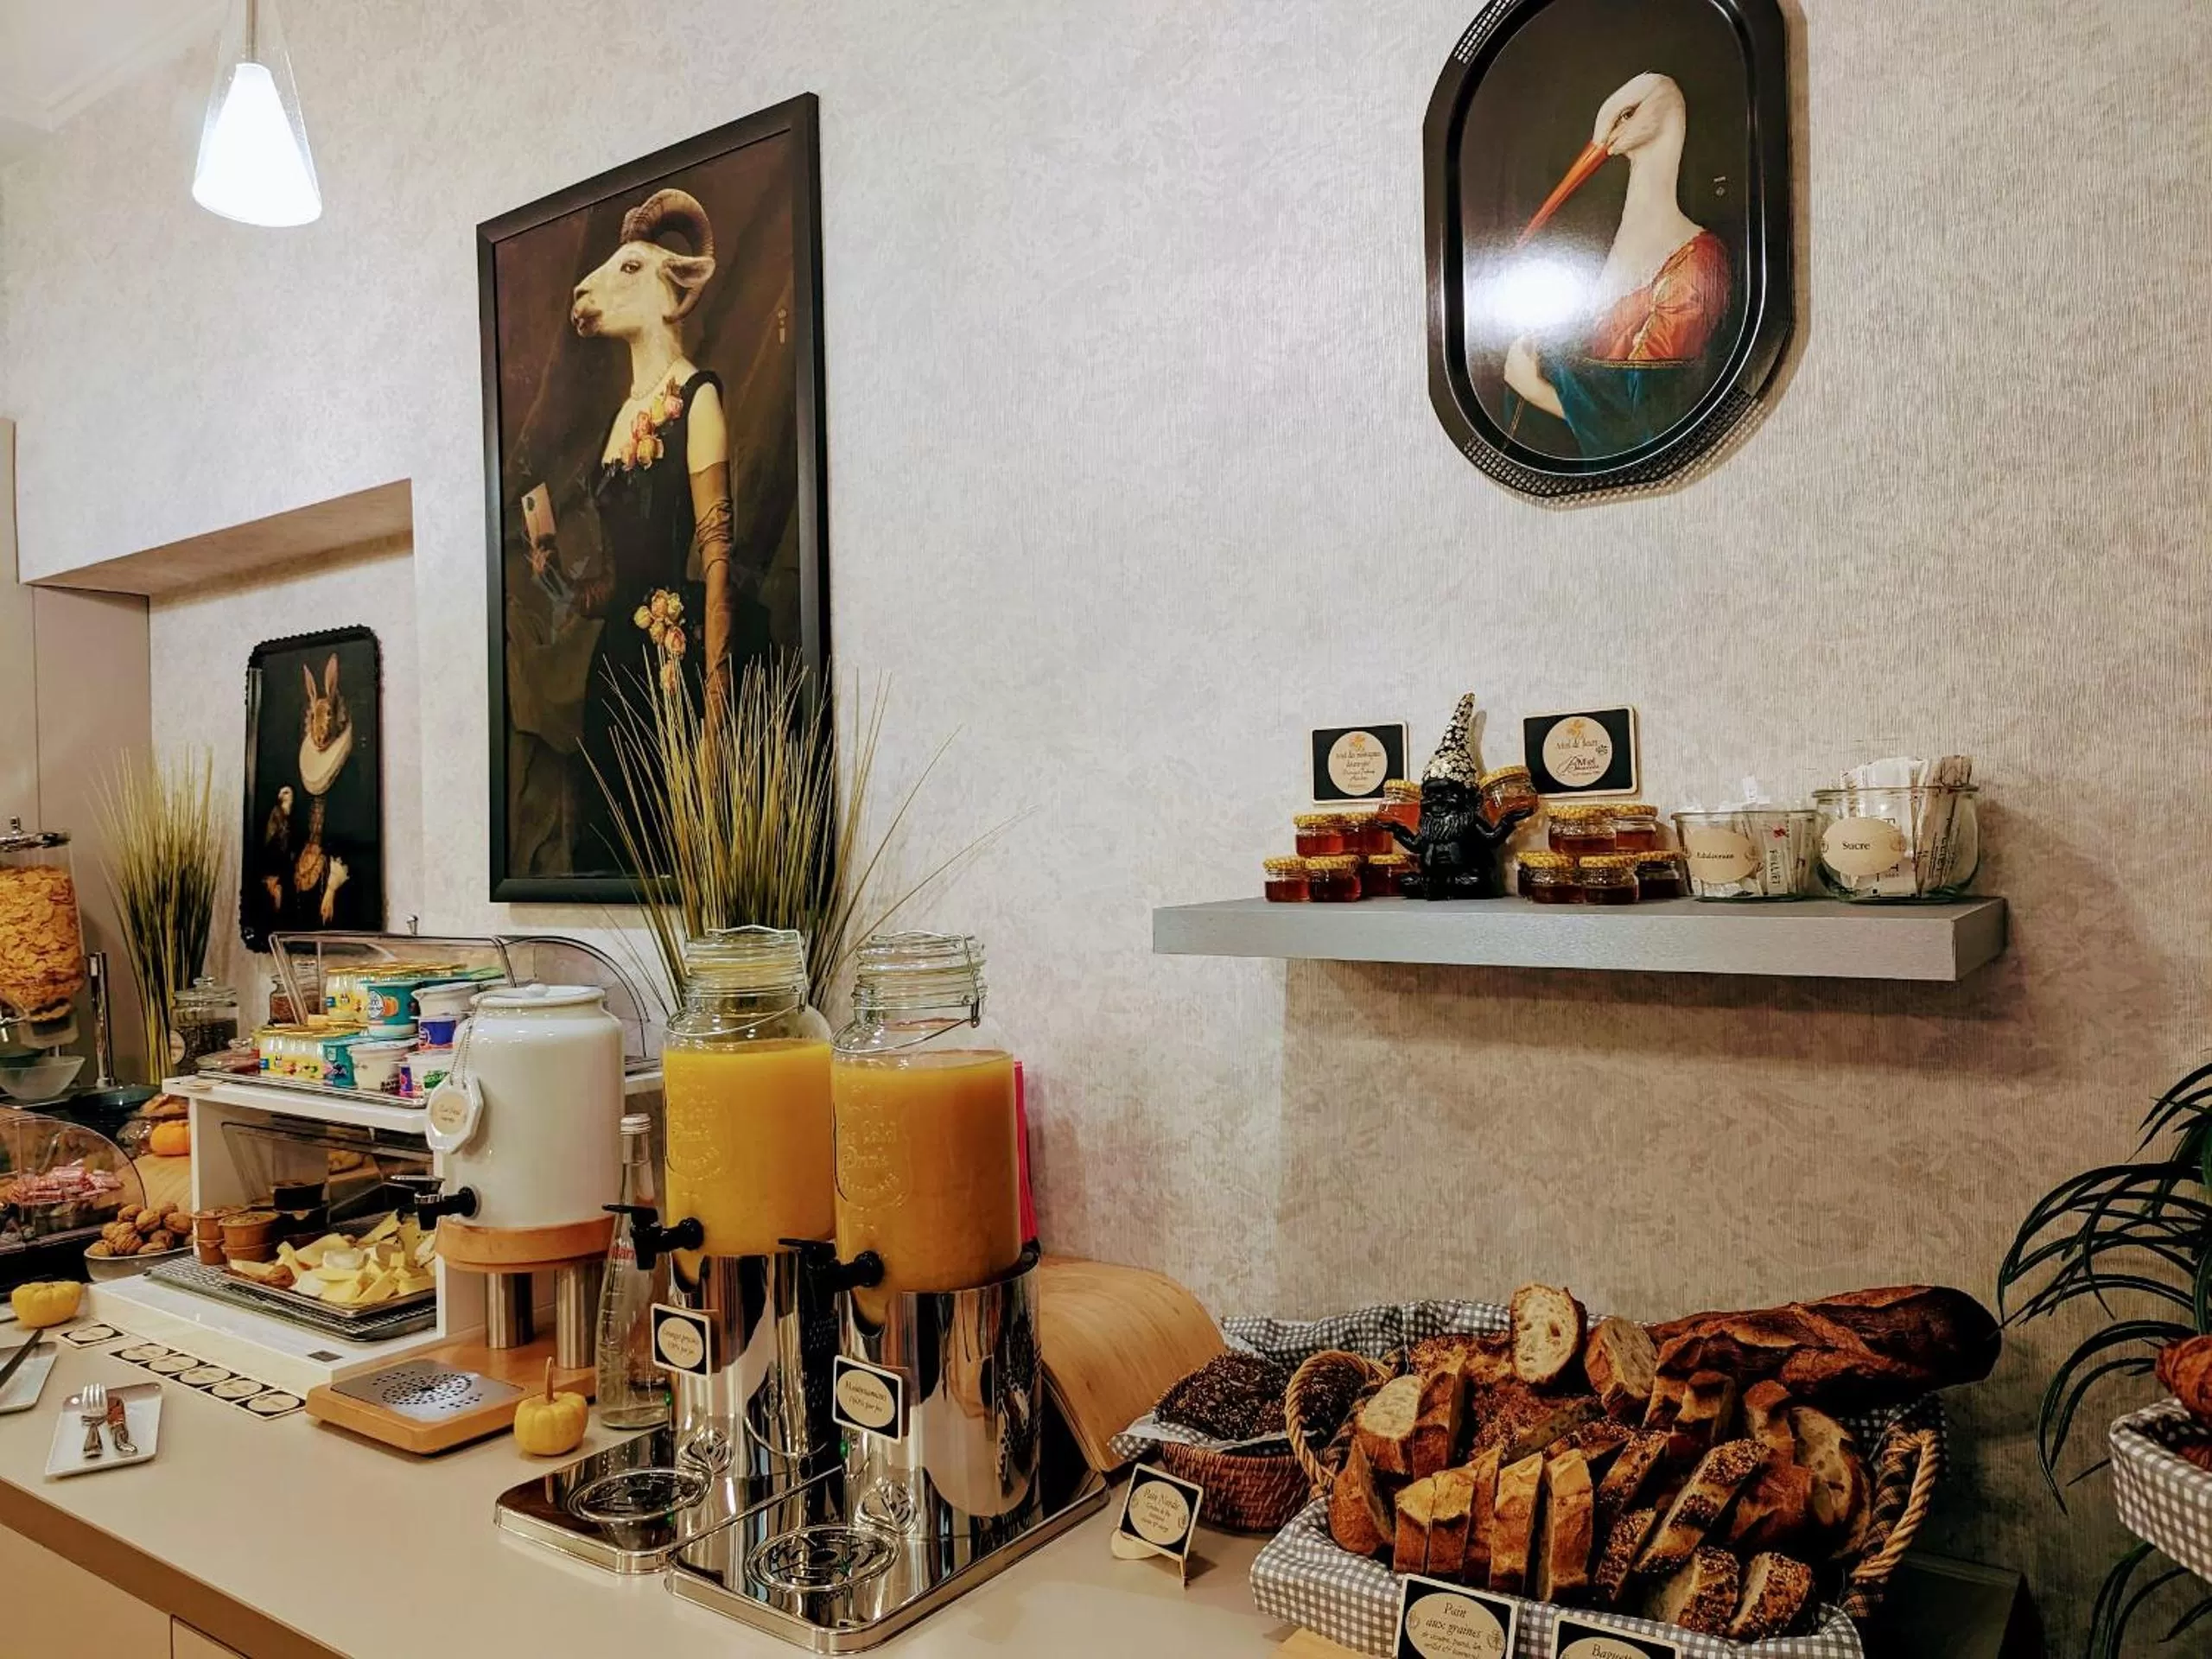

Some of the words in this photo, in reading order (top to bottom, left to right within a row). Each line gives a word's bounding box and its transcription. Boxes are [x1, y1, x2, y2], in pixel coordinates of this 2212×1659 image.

[1842, 842, 1871, 850] Sucre
[1444, 1601, 1466, 1618] Pain
[1426, 1618, 1446, 1630] aux
